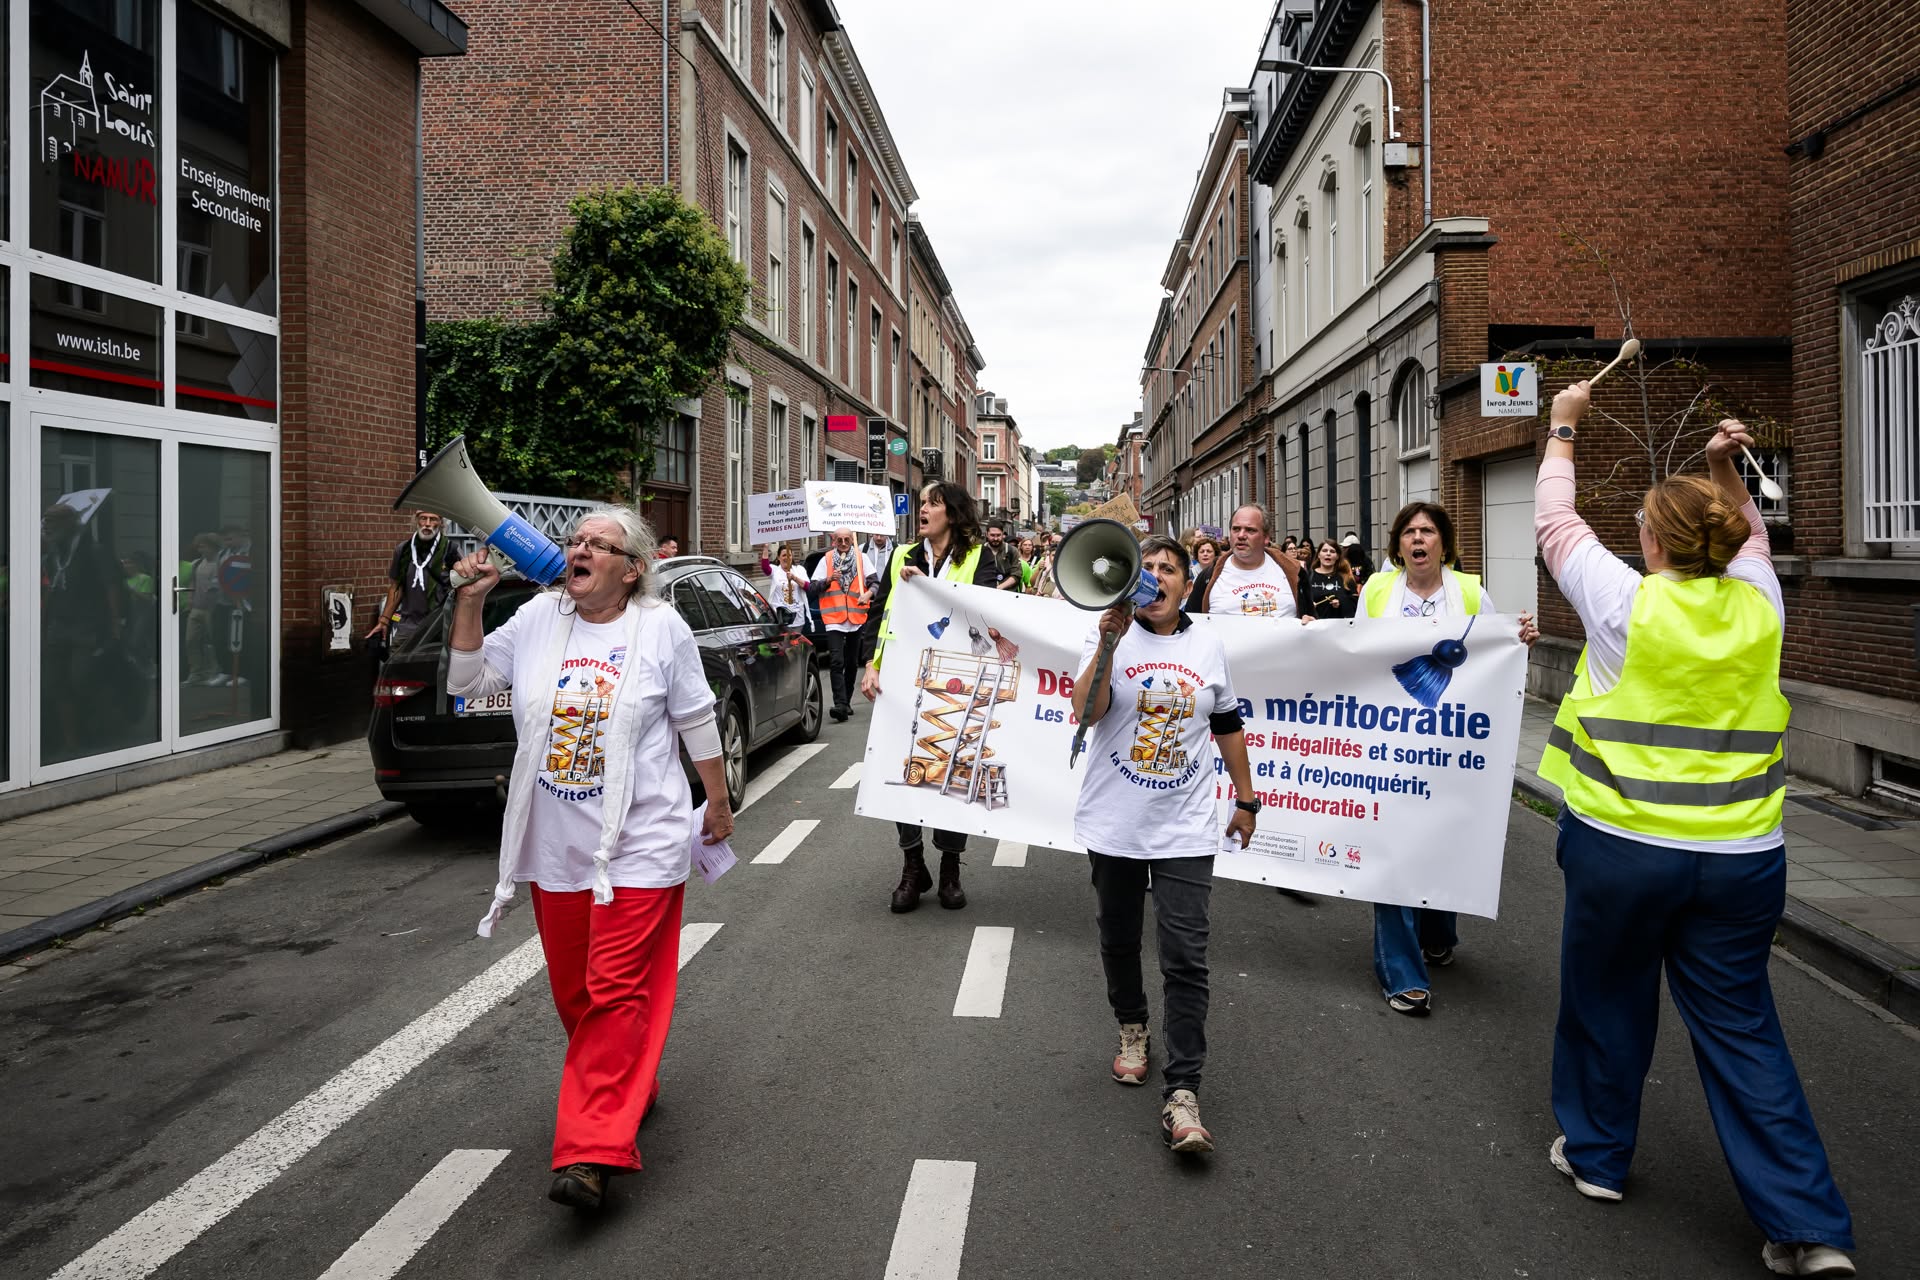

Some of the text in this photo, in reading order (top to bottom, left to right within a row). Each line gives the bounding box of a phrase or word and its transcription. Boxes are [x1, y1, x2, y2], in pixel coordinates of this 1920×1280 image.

[104, 104, 155, 147] Louis
[73, 152, 157, 206] NAMUR
[182, 158, 271, 212] Enseignement
[192, 190, 262, 232] Secondaire
[57, 331, 141, 361] www.isln.be
[1508, 399, 1533, 407] JEUNES
[768, 500, 805, 509] Méritocratie
[776, 508, 805, 516] inégalités
[897, 496, 906, 507] P
[506, 525, 536, 550] Manutan
[757, 525, 783, 534] FEMMES
[794, 522, 809, 530] LUTT
[561, 657, 621, 679] monton
[1125, 662, 1207, 687] Démontons
[1035, 703, 1064, 723] Les
[1037, 668, 1075, 698] Dé
[1265, 692, 1491, 739] méritocratie
[1271, 731, 1363, 758] inégalités
[1368, 742, 1388, 761] et
[1393, 747, 1452, 767] sortir
[1458, 750, 1486, 770] de
[1109, 751, 1121, 766] la
[1120, 758, 1200, 790] méritocratie
[1257, 760, 1431, 800] et à (re)conquérir,
[538, 776, 604, 801] méritocr
[1253, 788, 1366, 820] méritocratie
[1266, 835, 1298, 844] collaboration
[1271, 850, 1295, 858] associatif
